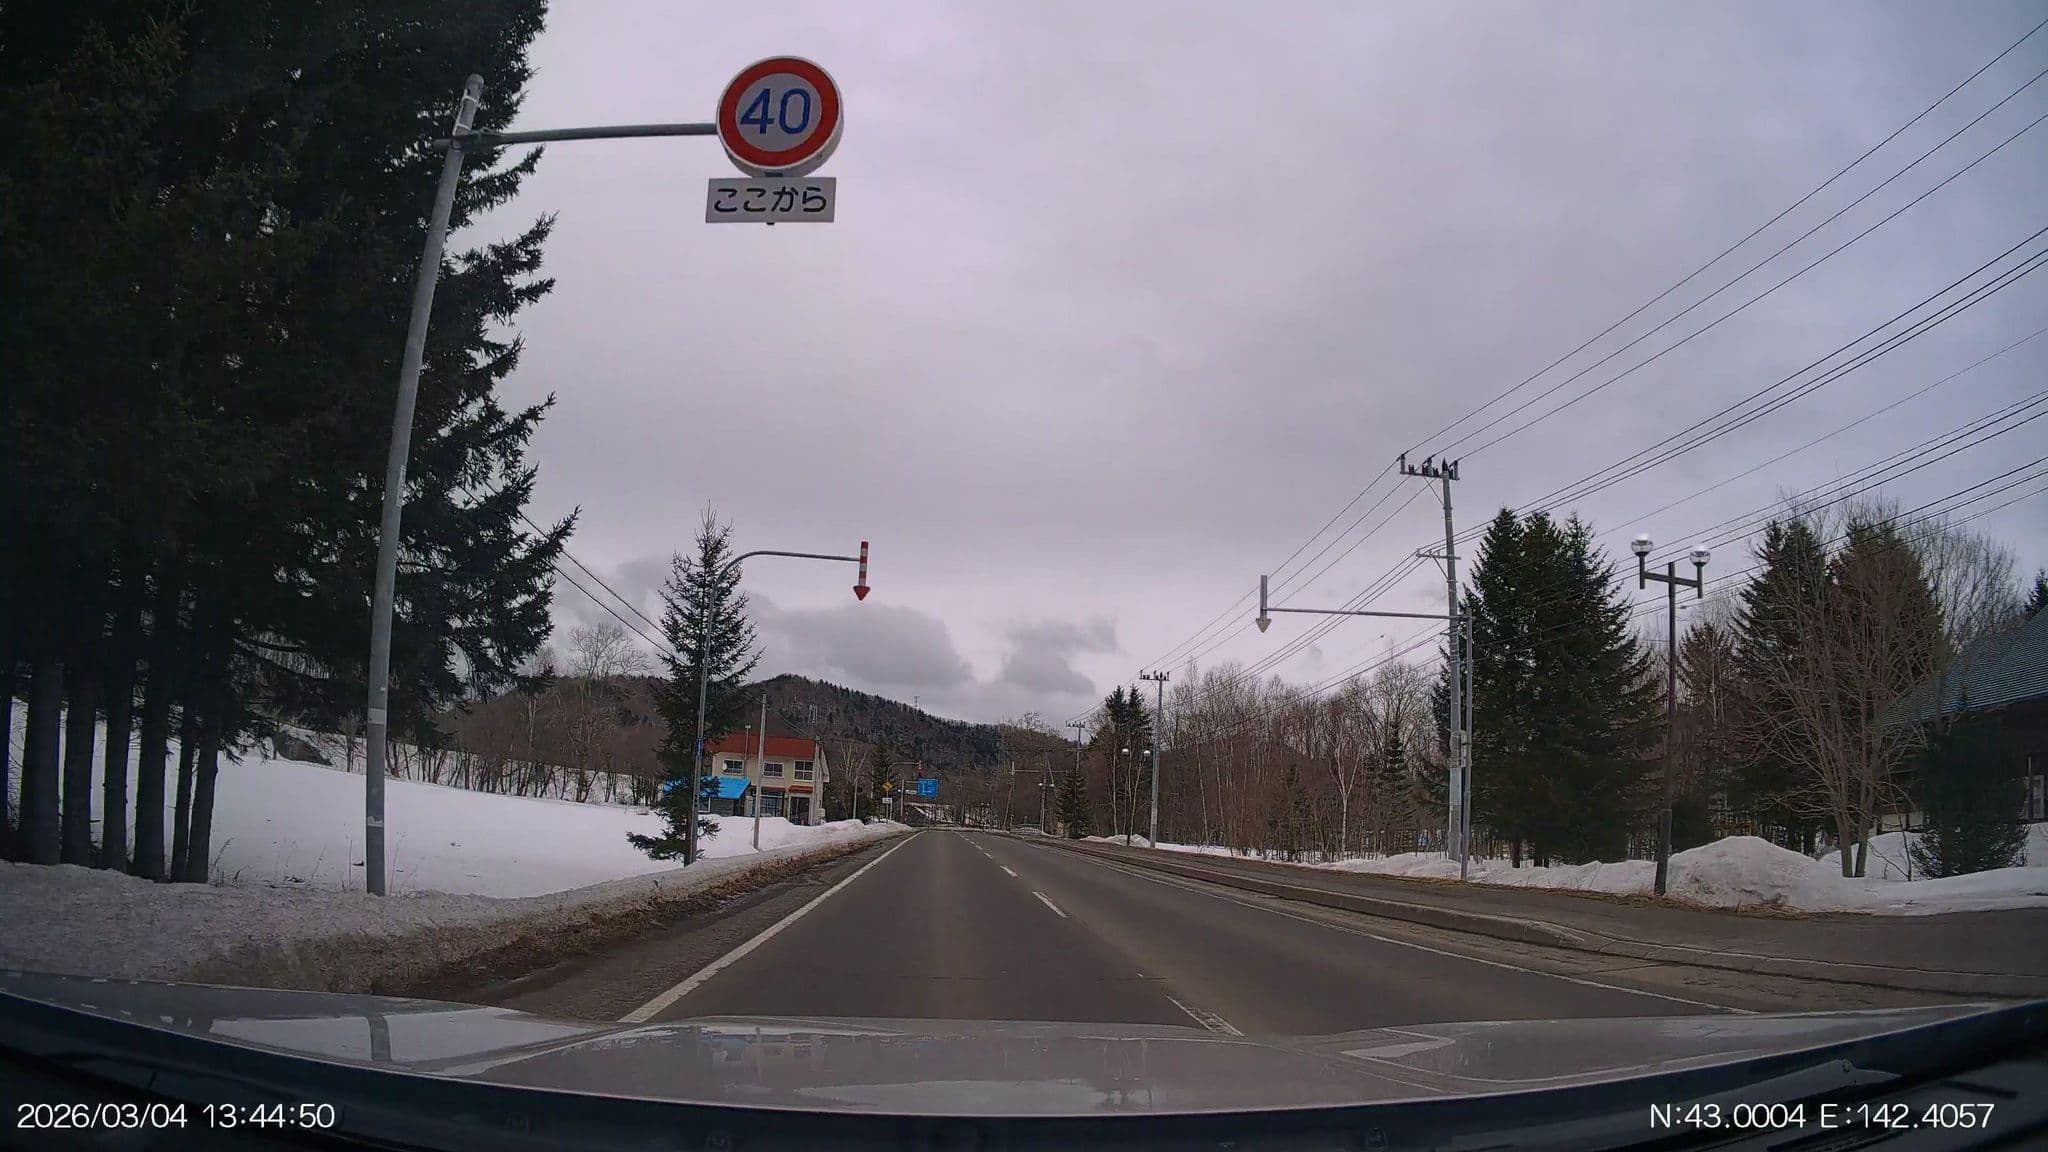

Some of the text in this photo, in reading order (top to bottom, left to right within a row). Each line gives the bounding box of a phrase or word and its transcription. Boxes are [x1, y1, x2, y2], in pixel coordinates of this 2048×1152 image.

[740, 88, 812, 135] 40
[713, 186, 828, 214] ここから
